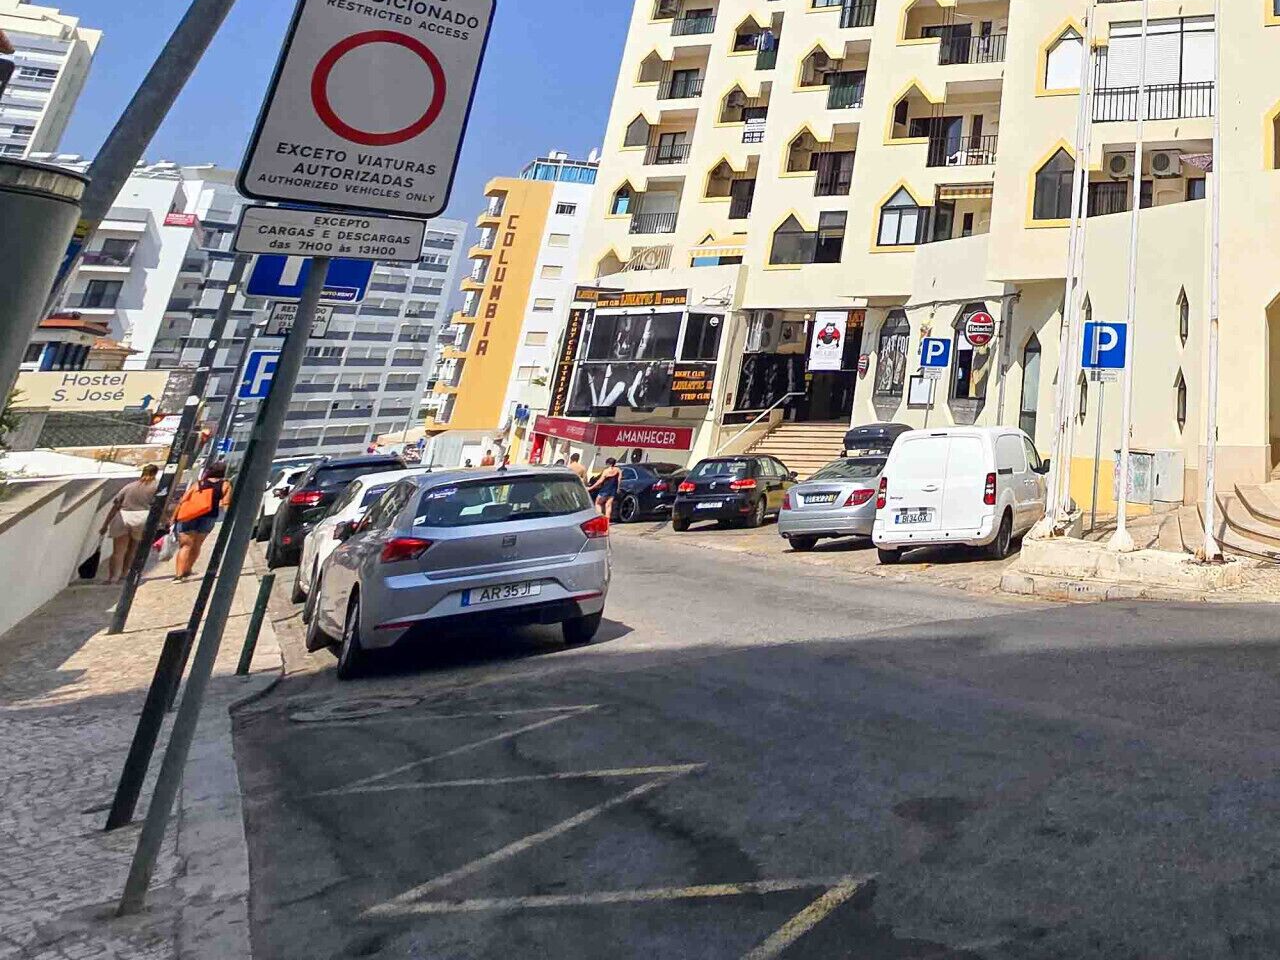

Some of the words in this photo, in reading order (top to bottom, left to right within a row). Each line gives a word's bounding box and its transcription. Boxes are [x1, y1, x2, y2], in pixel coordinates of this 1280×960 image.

[418, 21, 469, 41] ACCESS
[276, 142, 347, 162] EXCETO
[357, 153, 436, 176] VIATURAS
[293, 162, 414, 188] AUTORIZADAS
[257, 173, 339, 191] AUTHORIZED
[345, 184, 400, 199] VEHICLES
[406, 192, 436, 203] ONLY
[314, 216, 370, 229] EXCEPTO
[258, 225, 315, 237] CARGAS
[323, 229, 331, 239] E
[337, 231, 411, 244] DESCARGAS
[269, 240, 291, 249] das
[299, 241, 332, 252] 7H00
[358, 245, 396, 256] 13H00
[476, 214, 520, 356] COLUMBIA
[925, 340, 945, 365] P
[1090, 325, 1118, 365] P
[61, 373, 128, 386] Hostel
[51, 388, 69, 402] S.
[77, 388, 125, 401] José
[616, 430, 677, 444] AMANHECER
[480, 587, 501, 601] AR
[504, 584, 519, 598] 35
